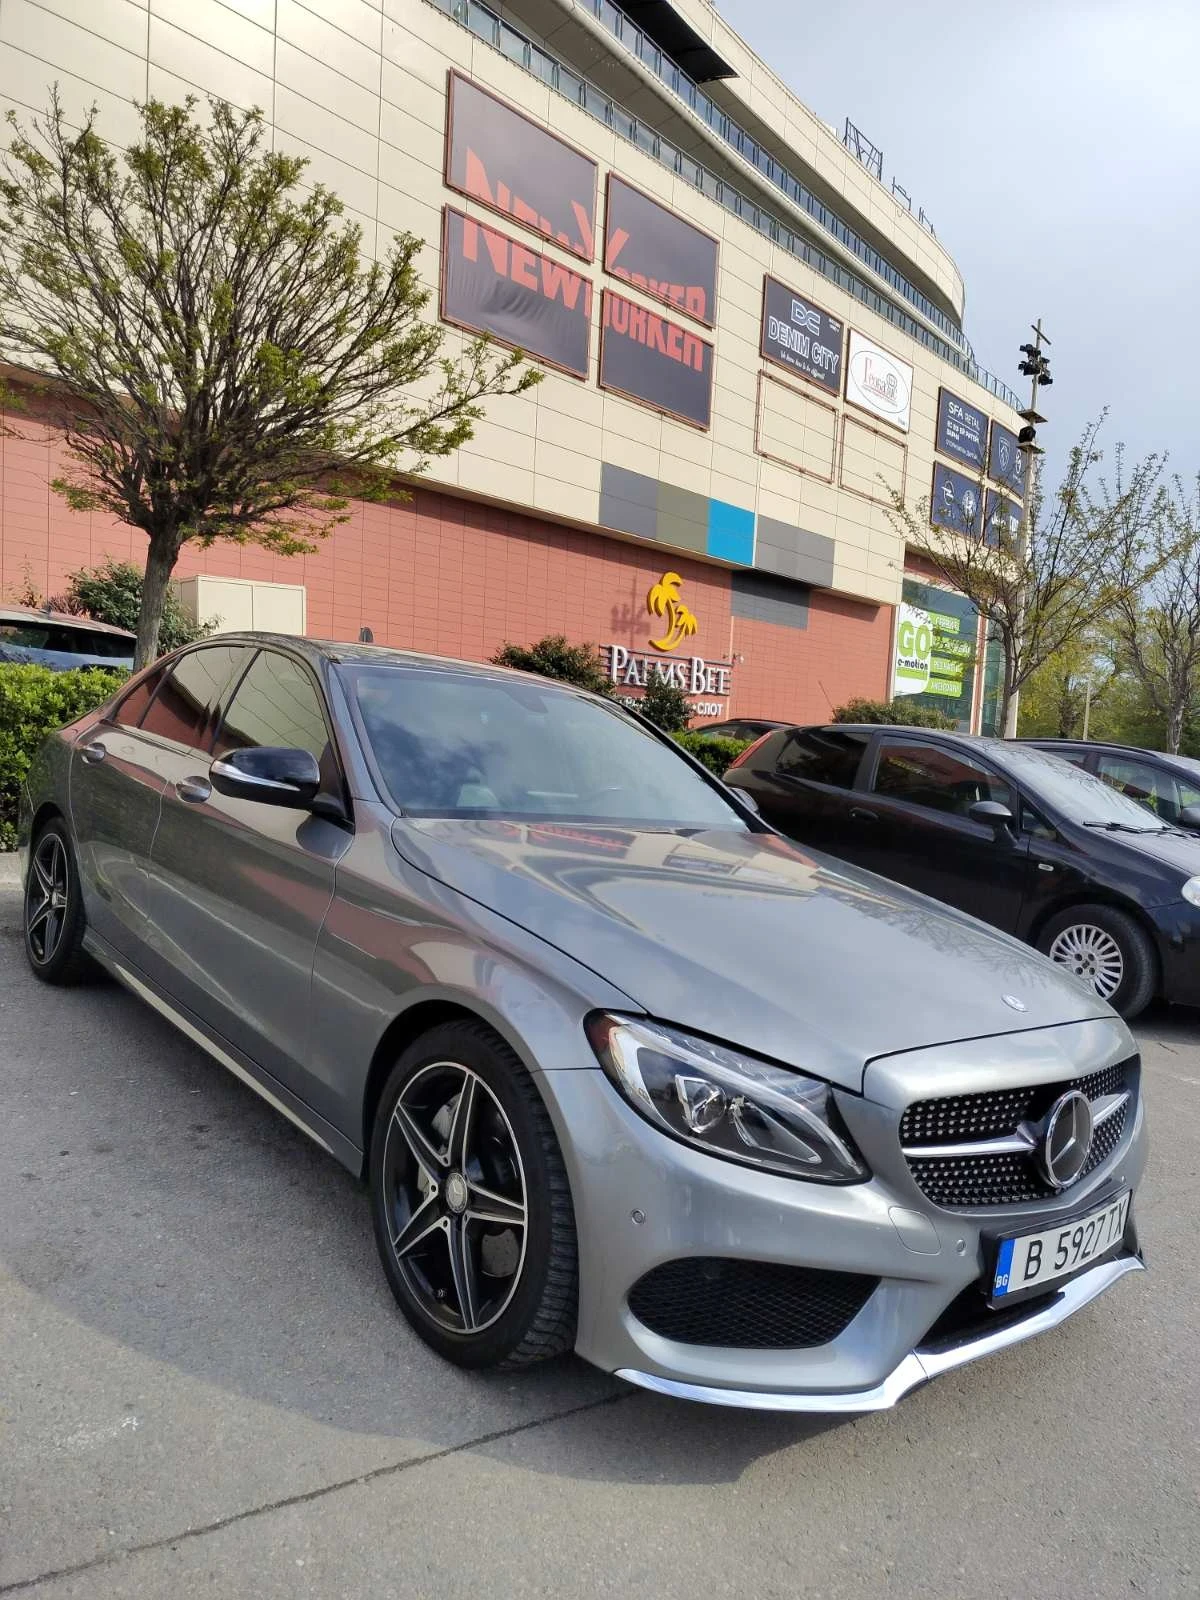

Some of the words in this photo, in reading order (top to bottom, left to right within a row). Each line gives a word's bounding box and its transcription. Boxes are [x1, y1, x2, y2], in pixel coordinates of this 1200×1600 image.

[463, 147, 583, 310] NEW
[768, 316, 810, 359] DENIM
[811, 342, 839, 374] CITY
[948, 401, 964, 420] SFA
[898, 621, 931, 660] GO
[610, 645, 686, 690] PALMS
[690, 657, 729, 694] BET
[897, 658, 929, 671] e-motion
[697, 702, 723, 716] СЛОТ
[1023, 1239, 1043, 1281] B
[995, 1273, 1008, 1288] BG
